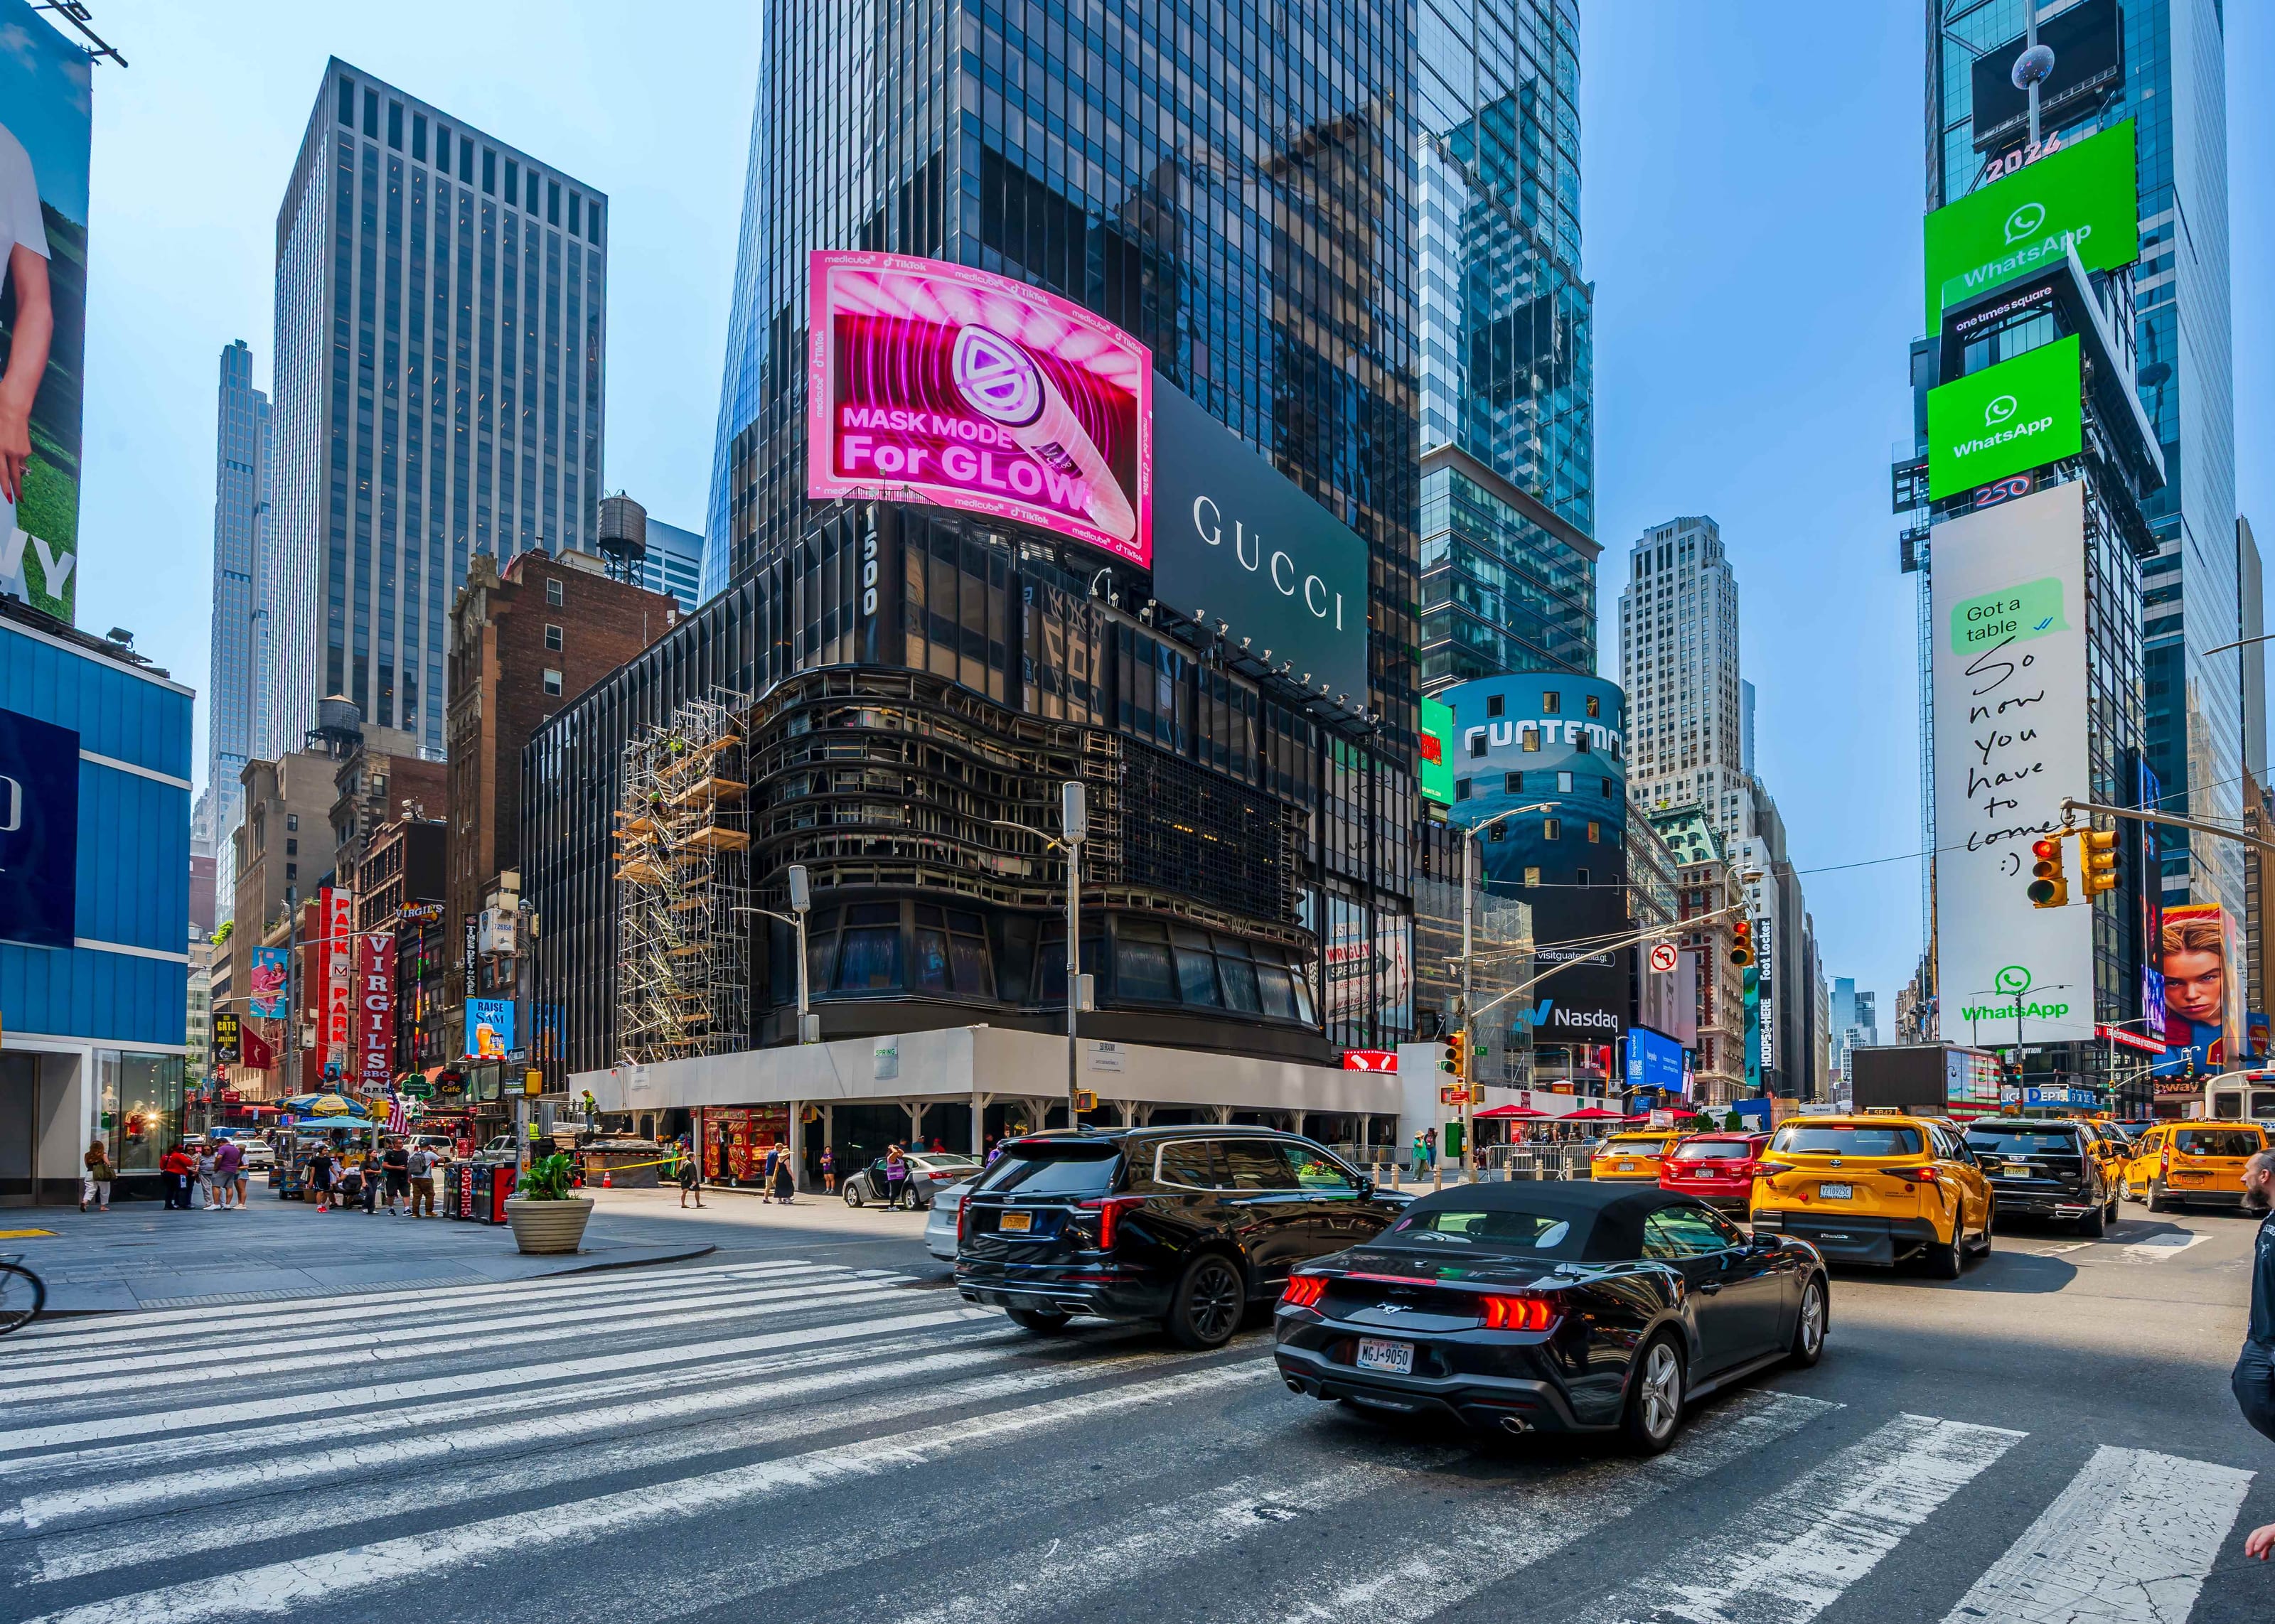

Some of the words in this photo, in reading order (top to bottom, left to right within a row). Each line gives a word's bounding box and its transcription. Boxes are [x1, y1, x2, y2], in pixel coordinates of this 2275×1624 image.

[1986, 131, 2061, 183] 2024
[825, 255, 875, 264] medicube
[894, 259, 926, 271] TikTok
[1964, 225, 2092, 287] WhatsApp
[955, 271, 1003, 286] medicube
[1021, 288, 1049, 305] TikTok
[1956, 317, 1976, 331] one
[1977, 303, 2010, 322] times
[2011, 286, 2052, 308] square
[815, 330, 824, 357] TikTok
[1072, 310, 1110, 333] medicube
[1123, 337, 1143, 355] TikTok
[813, 375, 823, 418] medicube
[843, 407, 926, 433] MASK
[932, 415, 1013, 449] MODE
[1954, 416, 2052, 457] WhatsApp
[844, 435, 928, 474] For
[941, 446, 1087, 511] GLOW
[955, 498, 1004, 512] medicube
[1022, 510, 1049, 525] TikTok
[863, 505, 878, 616] 1500
[1072, 527, 1110, 545] medicube
[1123, 547, 1143, 562] TikTok
[1193, 495, 1342, 631] GUCCI
[1967, 601, 2003, 621] Got
[2009, 599, 2020, 611] a
[1967, 620, 2017, 642] table
[1965, 635, 2034, 696] So
[1970, 690, 2044, 724] now
[1974, 729, 2037, 765] you
[1967, 763, 2043, 799] have
[1984, 797, 2018, 818] to
[1967, 822, 2060, 851] come
[336, 898, 349, 954] PARK
[466, 926, 476, 949] TIMES
[1760, 959, 1771, 980] Foot
[333, 988, 347, 1043] PARK
[365, 936, 389, 1069] VIRGILS
[476, 1012, 504, 1024] SAM
[478, 1001, 503, 1012] RAISE
[1760, 999, 1772, 1023] HERE
[1962, 1002, 2069, 1021] WhatsApp
[218, 1021, 236, 1031] CATS
[1555, 1009, 1618, 1033] Nasdaq
[876, 1048, 895, 1057] SPRING
[1761, 1035, 1772, 1067] HOOPS
[363, 1087, 388, 1095] BAR
[461, 1168, 472, 1217] CHICAGO
